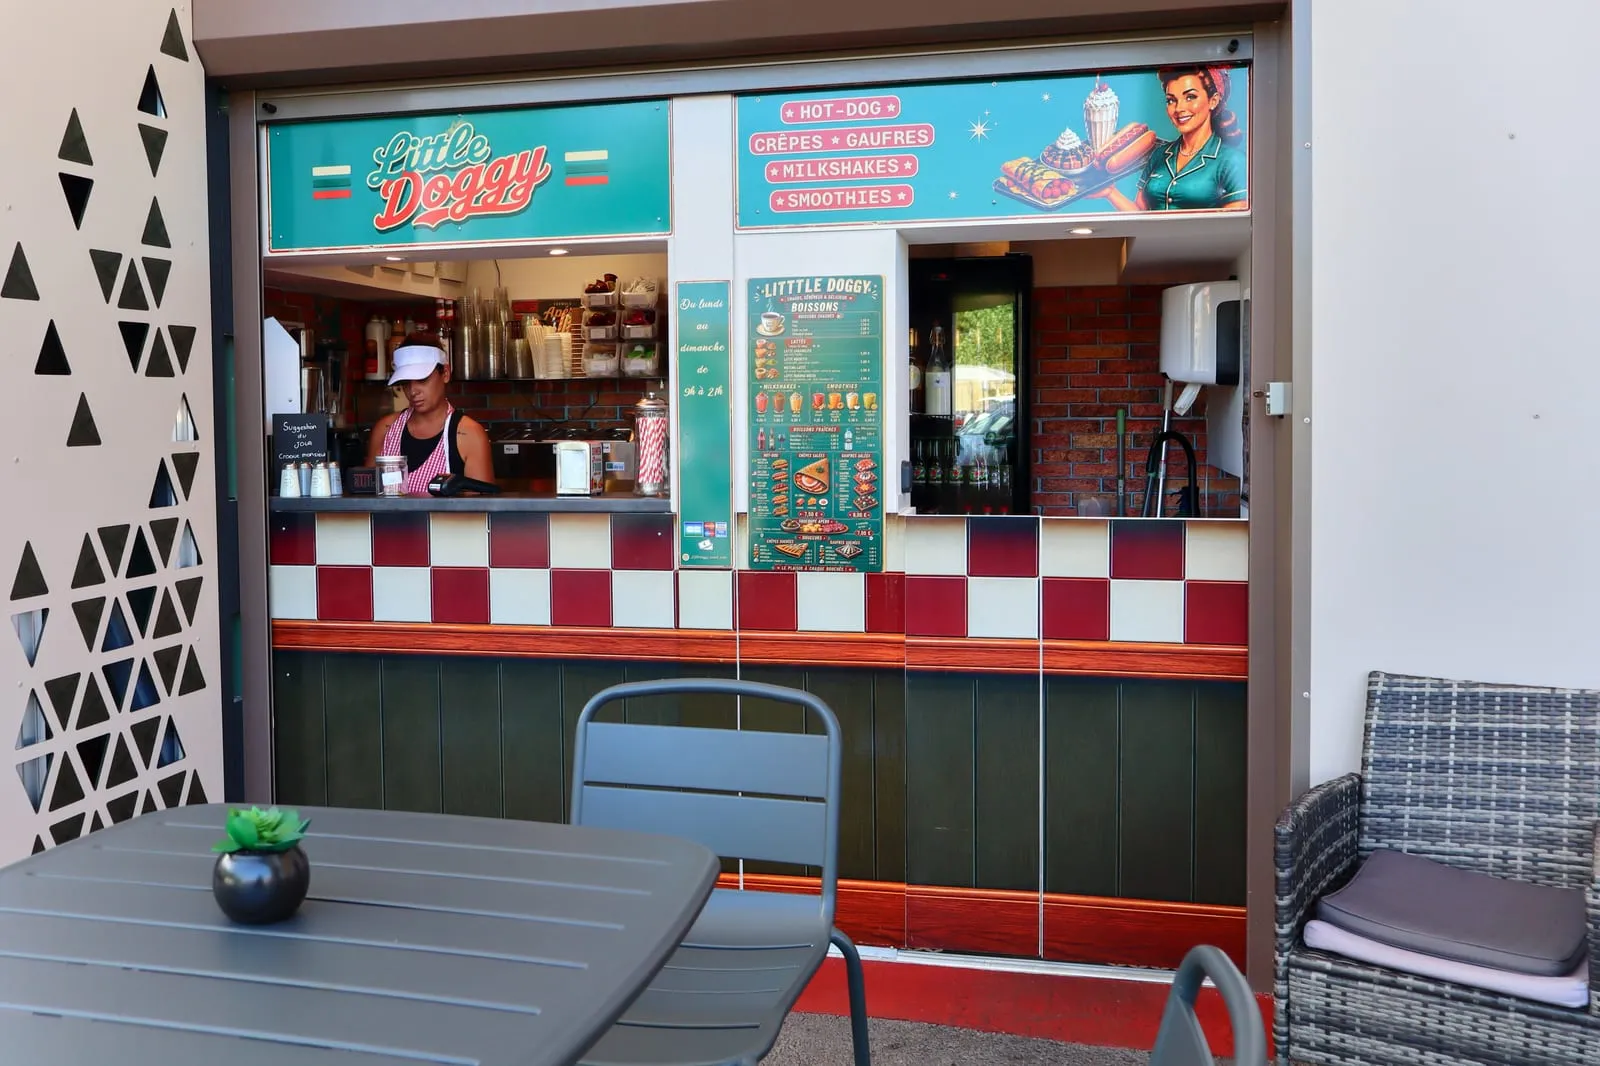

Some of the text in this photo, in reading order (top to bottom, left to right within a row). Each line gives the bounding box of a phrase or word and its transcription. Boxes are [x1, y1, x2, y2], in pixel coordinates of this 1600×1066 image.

[800, 100, 882, 119] HOT-DOG
[754, 129, 929, 152] CRÊPES GAUFRES
[366, 121, 490, 189] Little
[783, 158, 900, 178] MILKSHAKES
[373, 145, 551, 233] Doggy
[787, 189, 893, 208] SMOOTHIES
[827, 277, 872, 294] DOGGY
[680, 298, 723, 310] Du lundi
[791, 302, 839, 312] BOISSONS
[680, 341, 725, 353] dimanche
[696, 365, 709, 374] de
[283, 421, 317, 433] Suggestion
